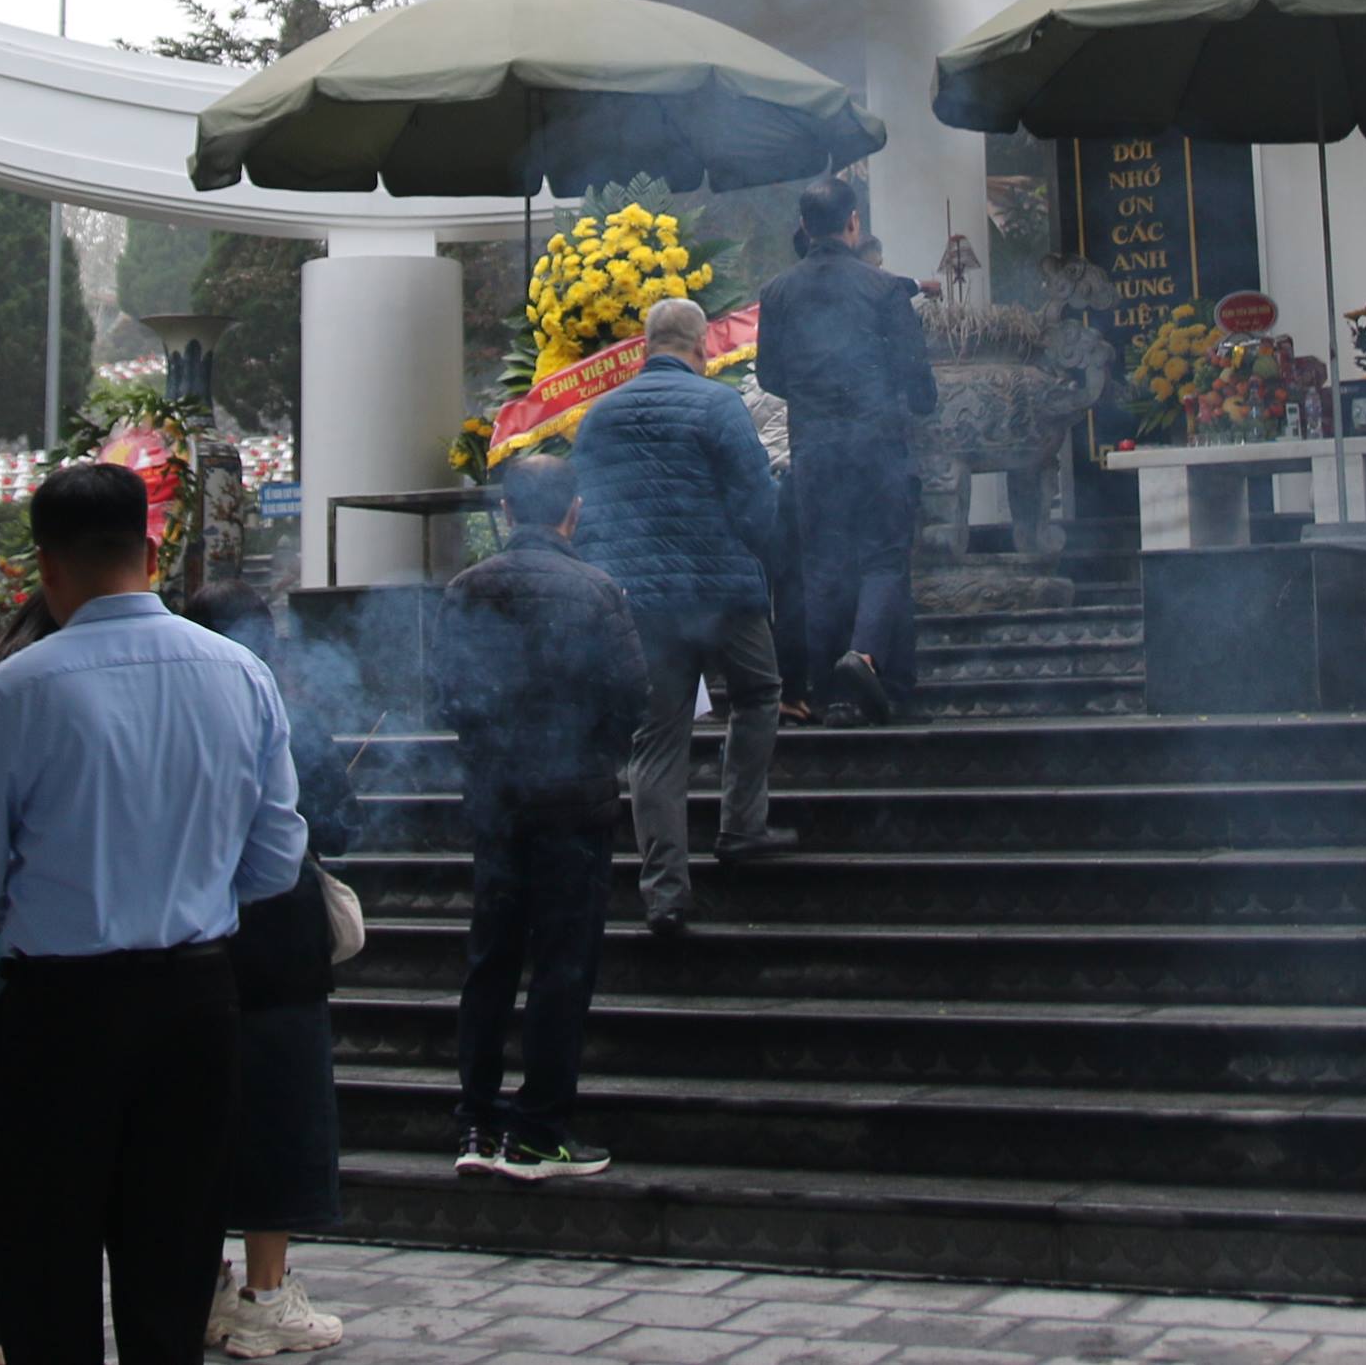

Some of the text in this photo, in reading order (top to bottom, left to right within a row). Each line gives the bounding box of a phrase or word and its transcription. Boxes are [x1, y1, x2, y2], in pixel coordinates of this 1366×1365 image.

[1108, 162, 1162, 190] NHỚ
[1118, 195, 1154, 217] ƠN
[1111, 219, 1165, 246] CÁC
[1112, 250, 1168, 272] ANH
[540, 373, 580, 402] BỆNH
[580, 355, 616, 383] VIỆN
